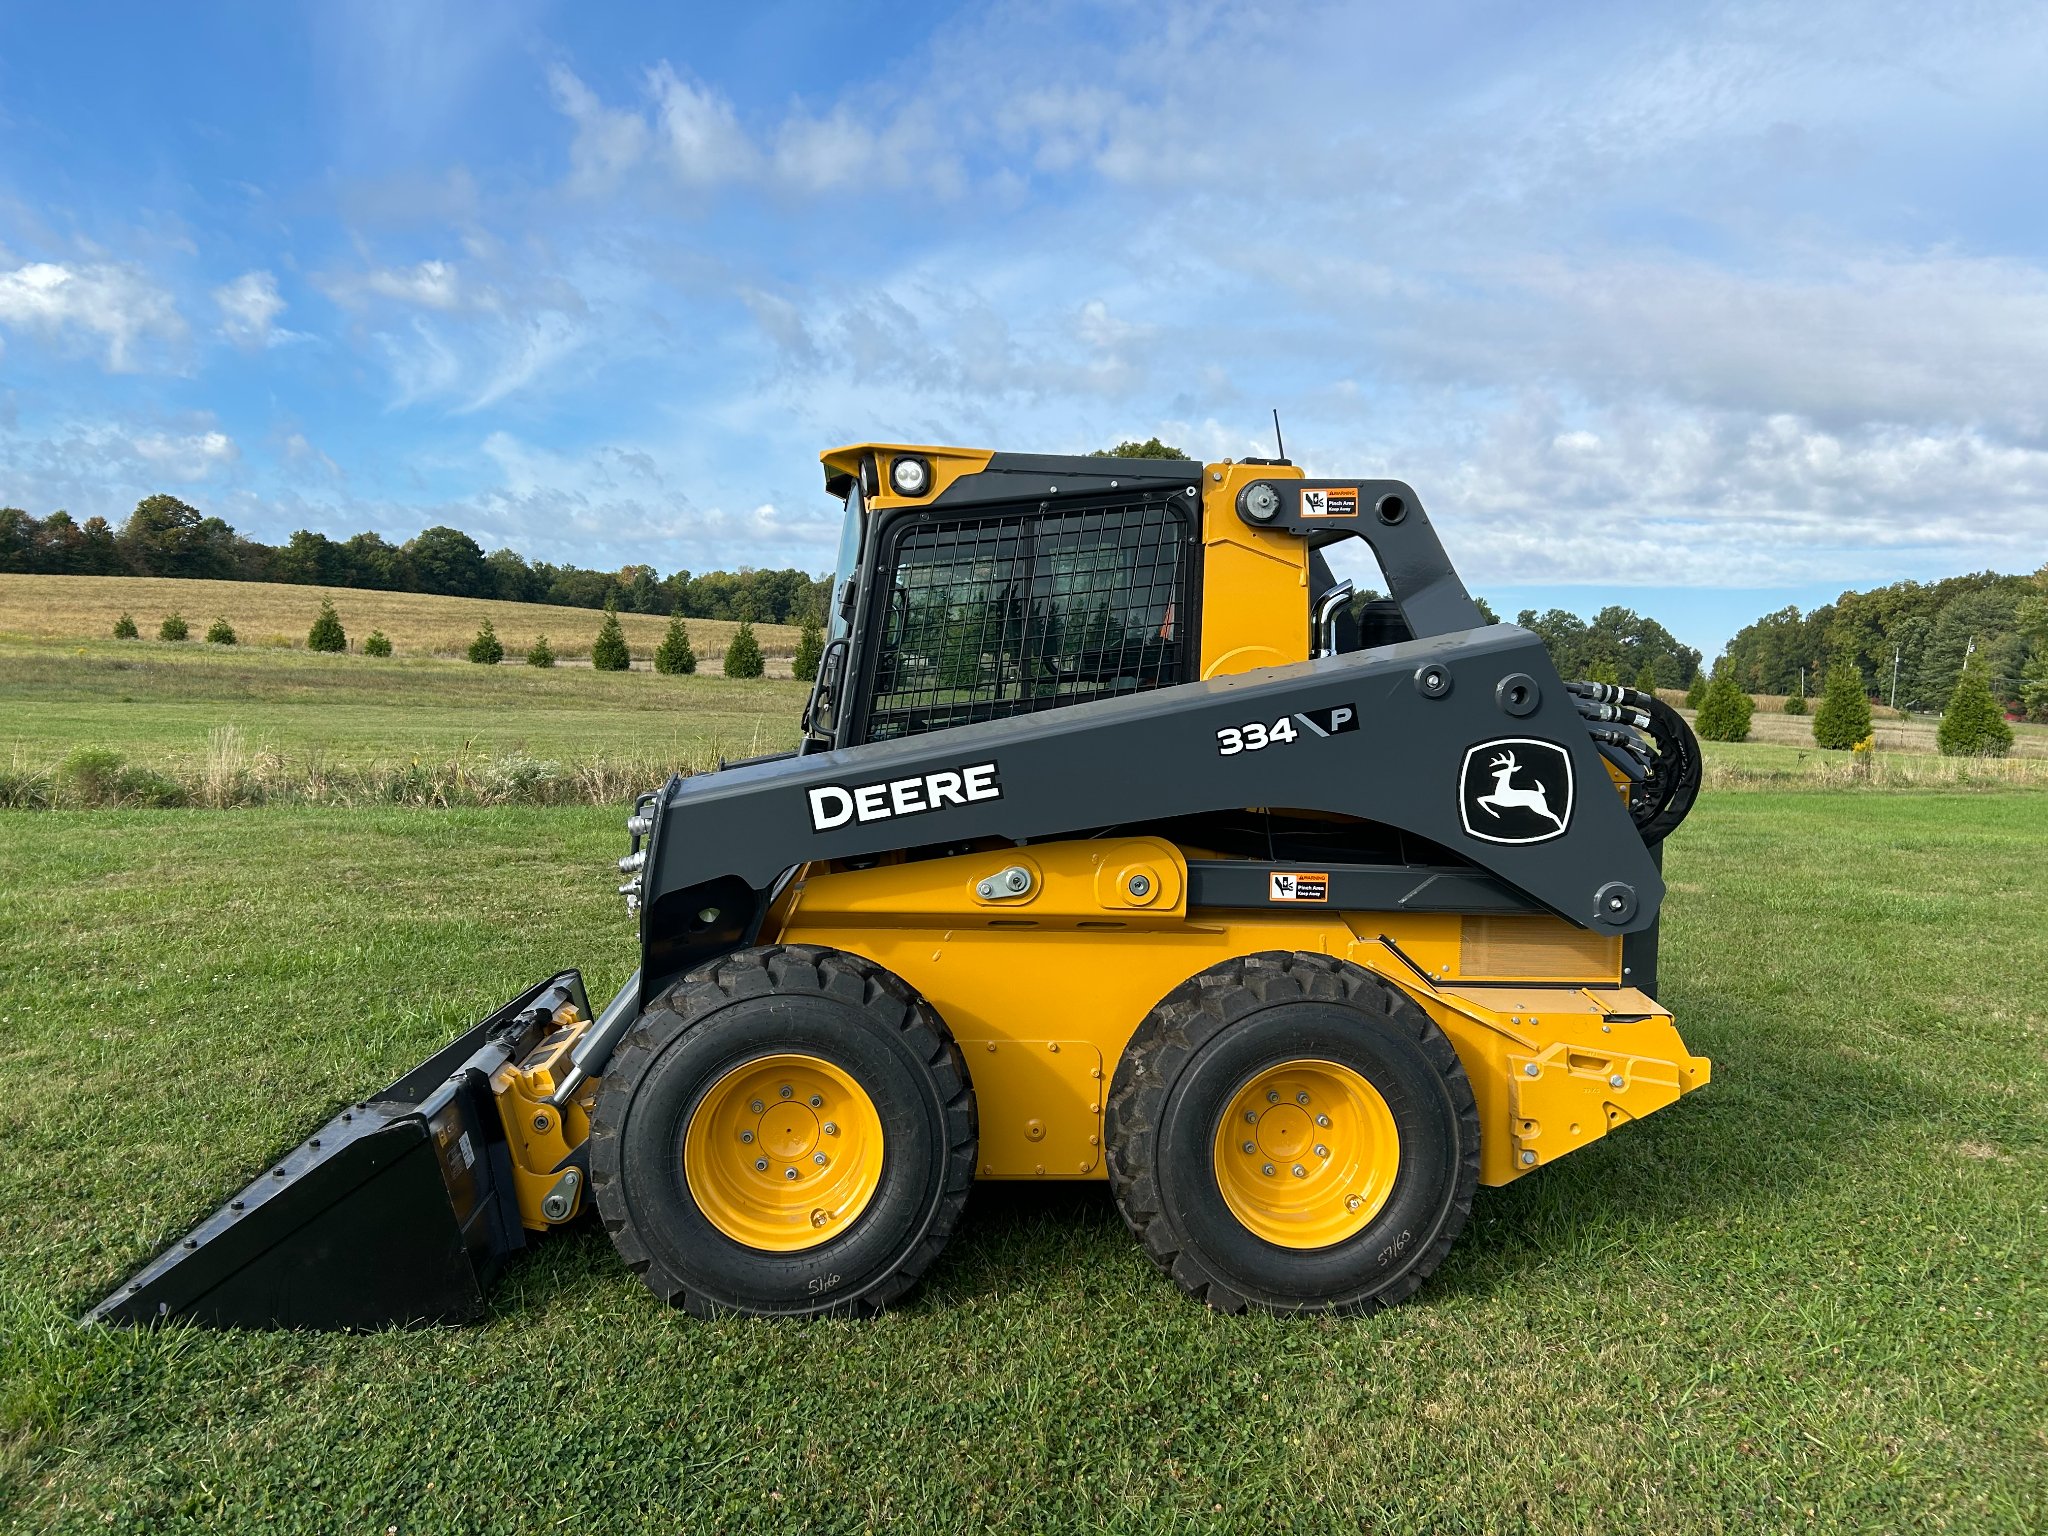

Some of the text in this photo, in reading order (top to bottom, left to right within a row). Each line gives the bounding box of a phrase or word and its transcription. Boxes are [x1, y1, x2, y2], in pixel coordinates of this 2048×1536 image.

[1217, 707, 1353, 756] 334 P
[808, 763, 1000, 831] DEERE
